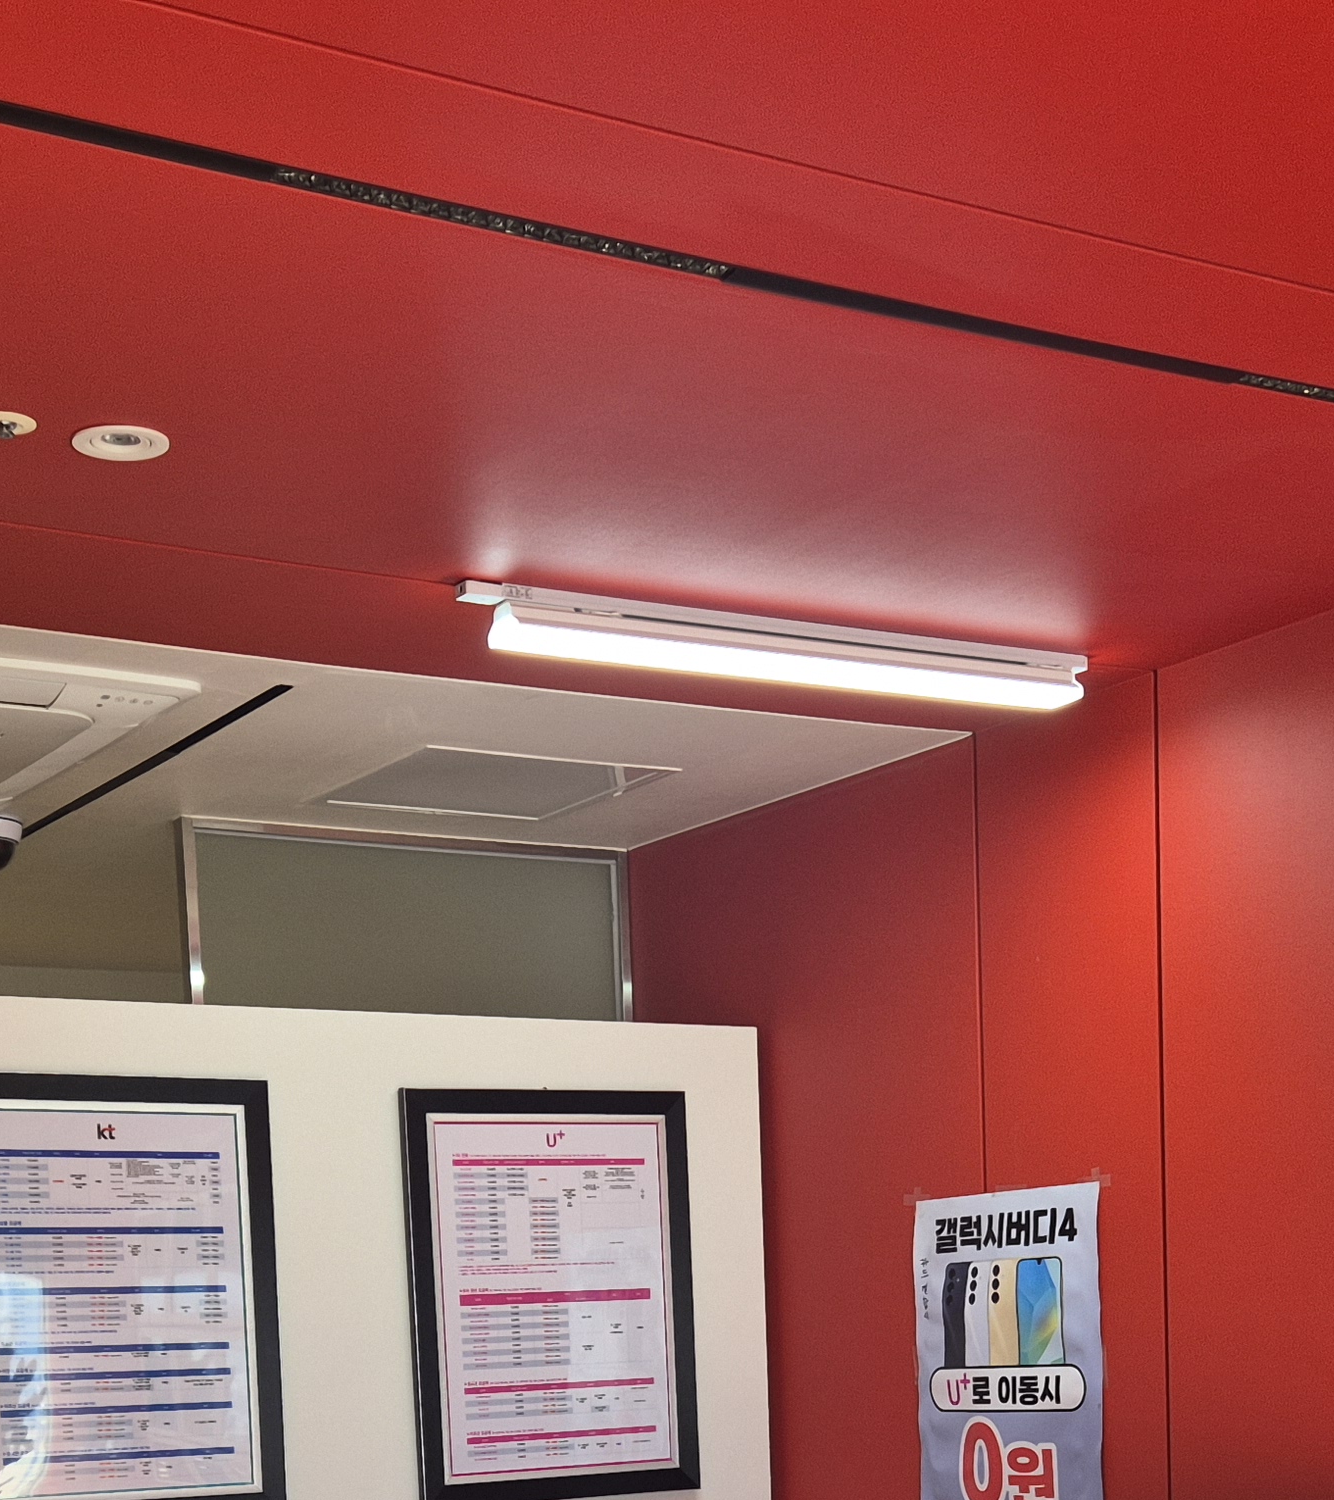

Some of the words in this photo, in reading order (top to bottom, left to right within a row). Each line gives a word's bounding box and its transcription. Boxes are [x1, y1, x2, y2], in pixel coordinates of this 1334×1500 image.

[97, 1123, 116, 1140] kt
[546, 1129, 565, 1147] U+
[935, 1207, 1078, 1255] 갤럭시버디4
[998, 1375, 1061, 1406] 이동시
